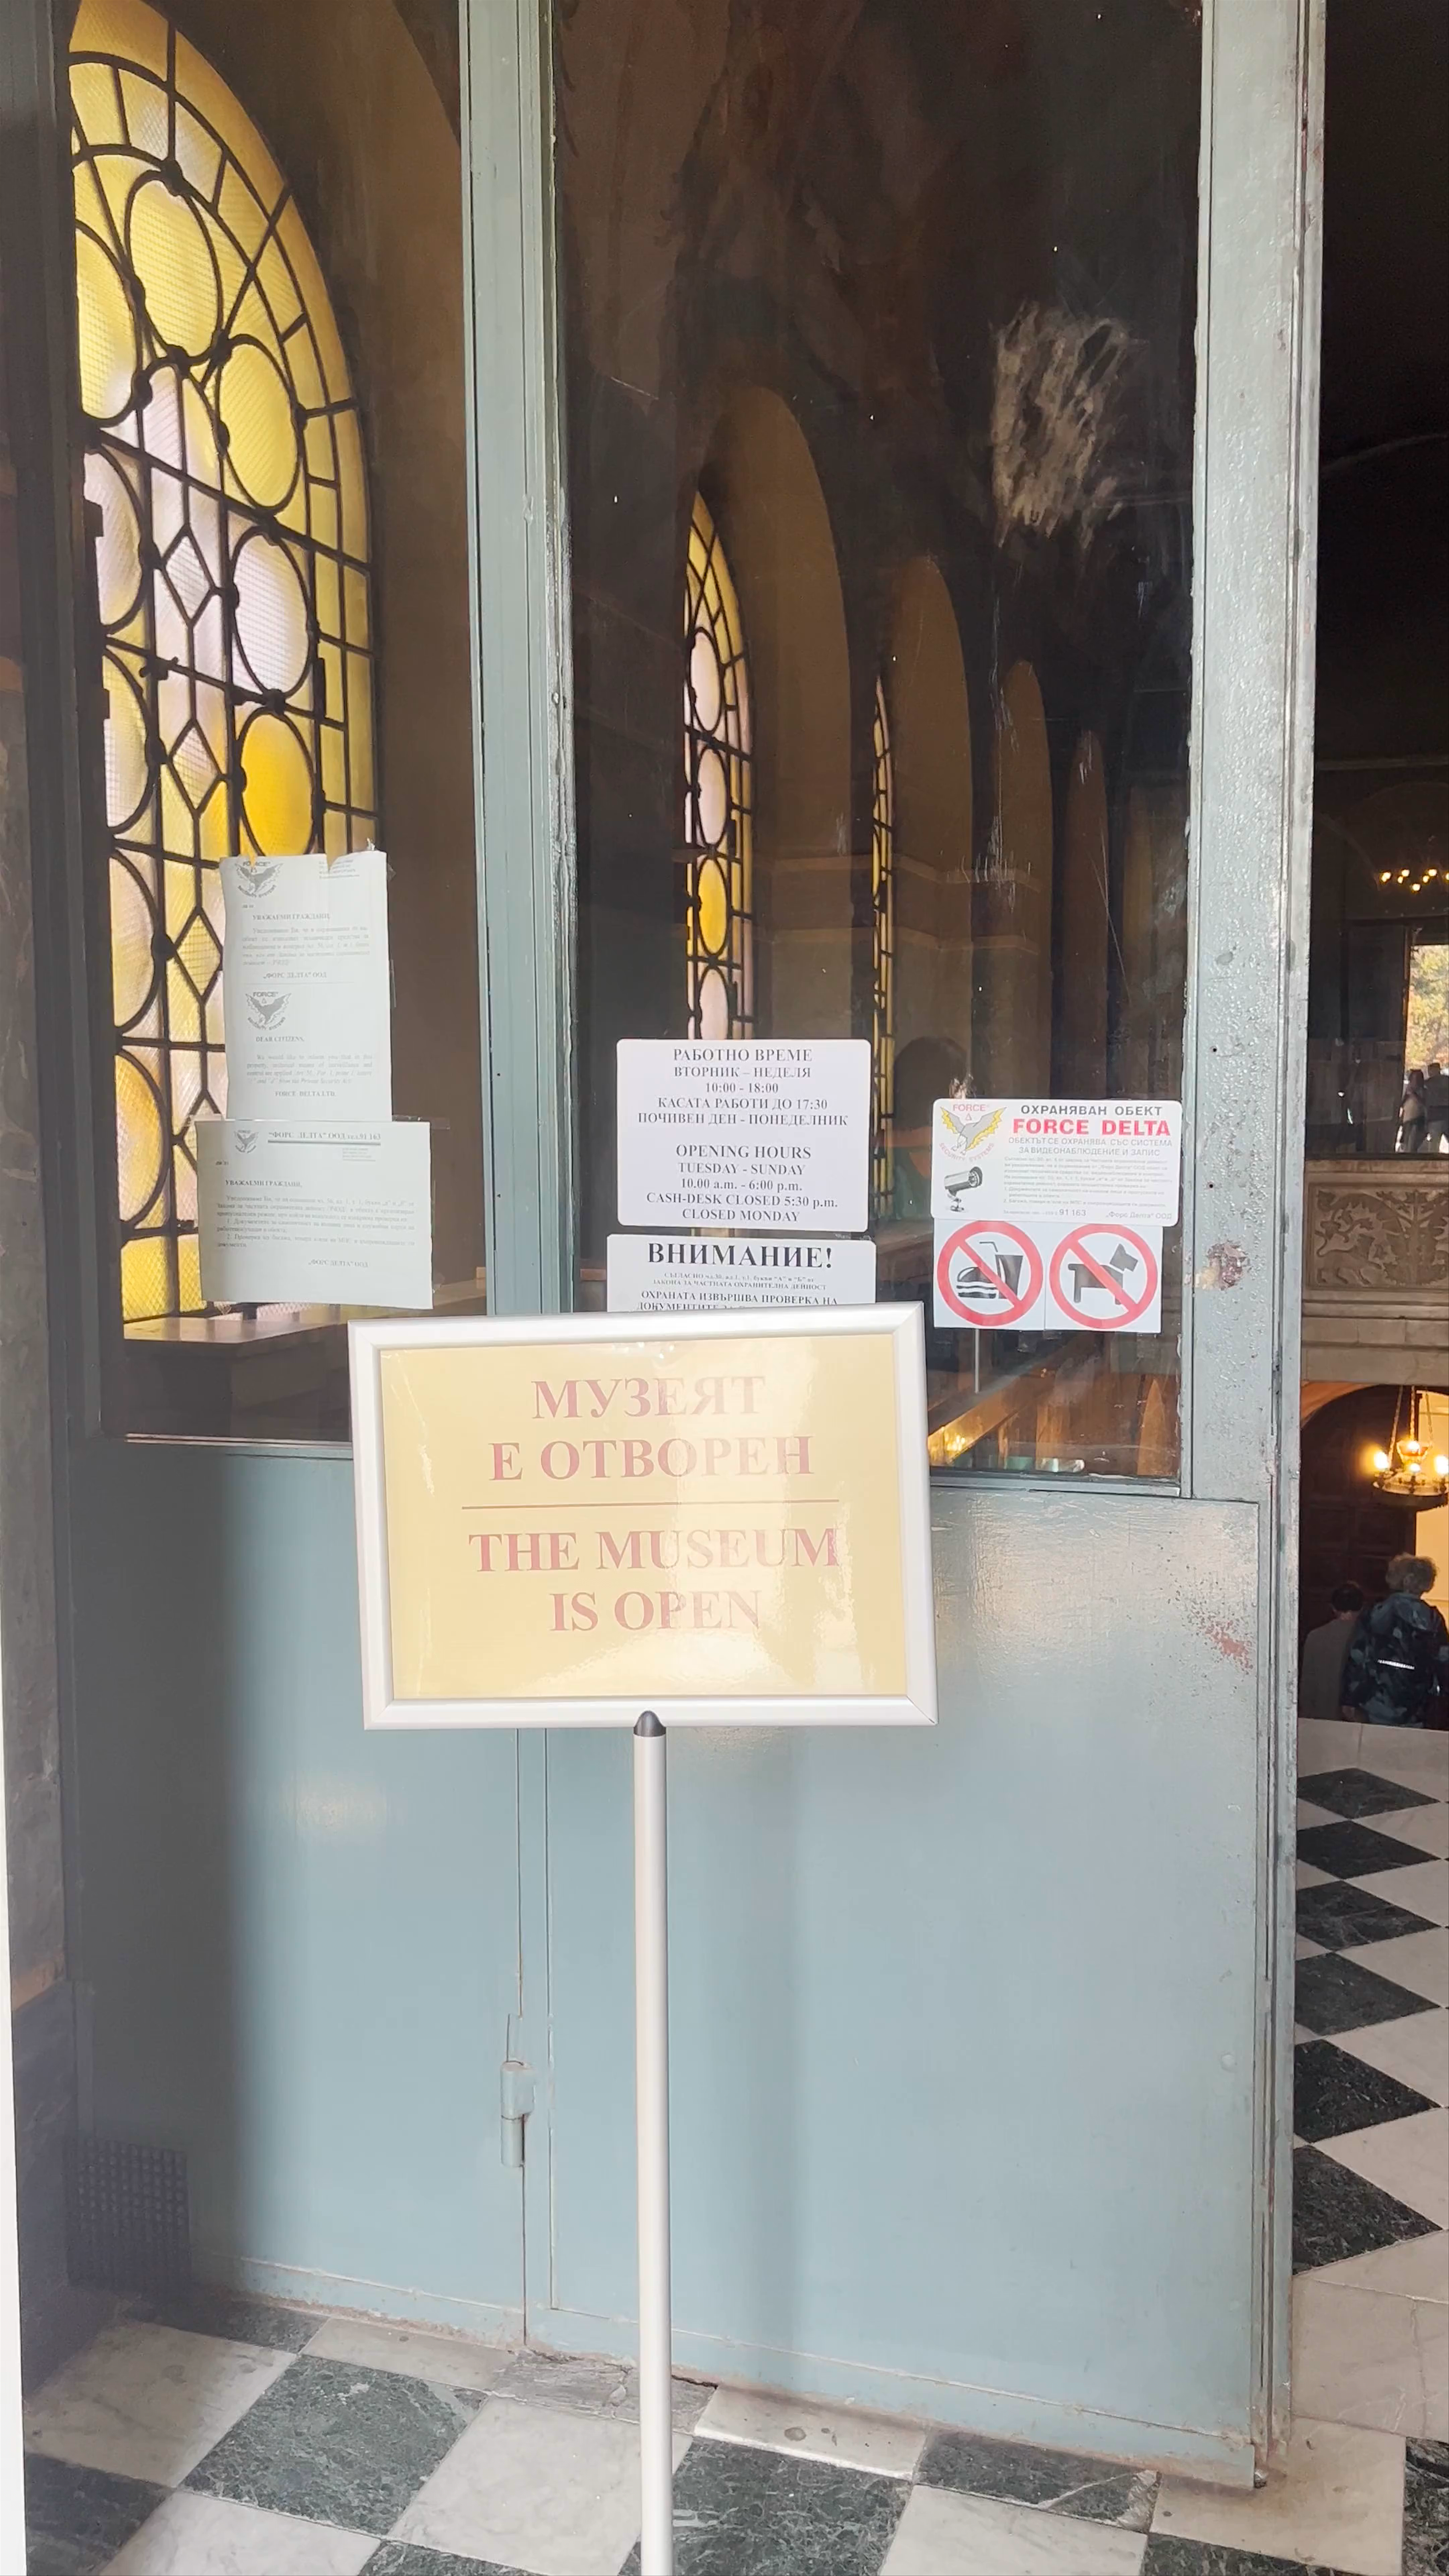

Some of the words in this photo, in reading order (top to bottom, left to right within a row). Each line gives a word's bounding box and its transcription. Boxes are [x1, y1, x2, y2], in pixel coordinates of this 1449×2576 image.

[673, 1049, 749, 1061] РАБОТНО
[755, 1049, 812, 1062] ВРЕМЕ
[674, 1067, 740, 1077] ВТОРНИК
[754, 1067, 811, 1079] НЕДЕЛЯ
[706, 1083, 736, 1093] 10:00
[748, 1083, 779, 1093] 18:00
[658, 1098, 711, 1108] КАСАТА
[715, 1098, 768, 1109] РАБОТИ
[772, 1099, 792, 1111] ДО
[797, 1099, 828, 1110] 17:30
[1020, 1105, 1107, 1115] ОХРАНЯВАН
[1115, 1106, 1163, 1116] ОБЕКТ
[638, 1113, 705, 1124] ПОЧИВЕН
[708, 1113, 736, 1126] ДЕН
[749, 1114, 848, 1126] ПОНЕДЕЛНИК
[1012, 1118, 1089, 1135] FORCE
[1102, 1120, 1171, 1136] DELTA
[676, 1144, 749, 1158] OPENING
[755, 1146, 811, 1159] HOURS
[938, 1143, 966, 1161] SECURITY
[969, 1142, 995, 1161] SYSTEMS
[1031, 1147, 1120, 1156] ВИДЕОНАБЛЮДЕНИЕ
[678, 1163, 739, 1174] TUESDAY
[751, 1164, 806, 1175] SUNDAY
[681, 1178, 710, 1189] 10.00
[749, 1180, 773, 1190] 6:00
[777, 1183, 803, 1193] p.m.
[646, 1192, 723, 1204] CASH-DESK
[726, 1194, 781, 1206] CLOSED
[784, 1196, 809, 1207] 5:30
[812, 1199, 838, 1209] p.m.
[682, 1209, 736, 1220] CLOSED
[740, 1210, 800, 1222] MONDAY
[648, 1243, 832, 1268] ВНИМАНИЕ!
[641, 1290, 696, 1300] ОХРАНАТА
[700, 1292, 758, 1303] ИЗВЪРШВА
[762, 1294, 819, 1304] ПРОВЕРКА
[823, 1297, 838, 1305] НА
[530, 1375, 767, 1421] МУЗЕЯТ
[488, 1442, 523, 1481] Е
[540, 1435, 814, 1481] ОТВОРЕН
[469, 1531, 580, 1573] THE
[594, 1527, 839, 1571] MUSEUM
[549, 1592, 598, 1632] IS
[614, 1589, 762, 1632] OPEN
